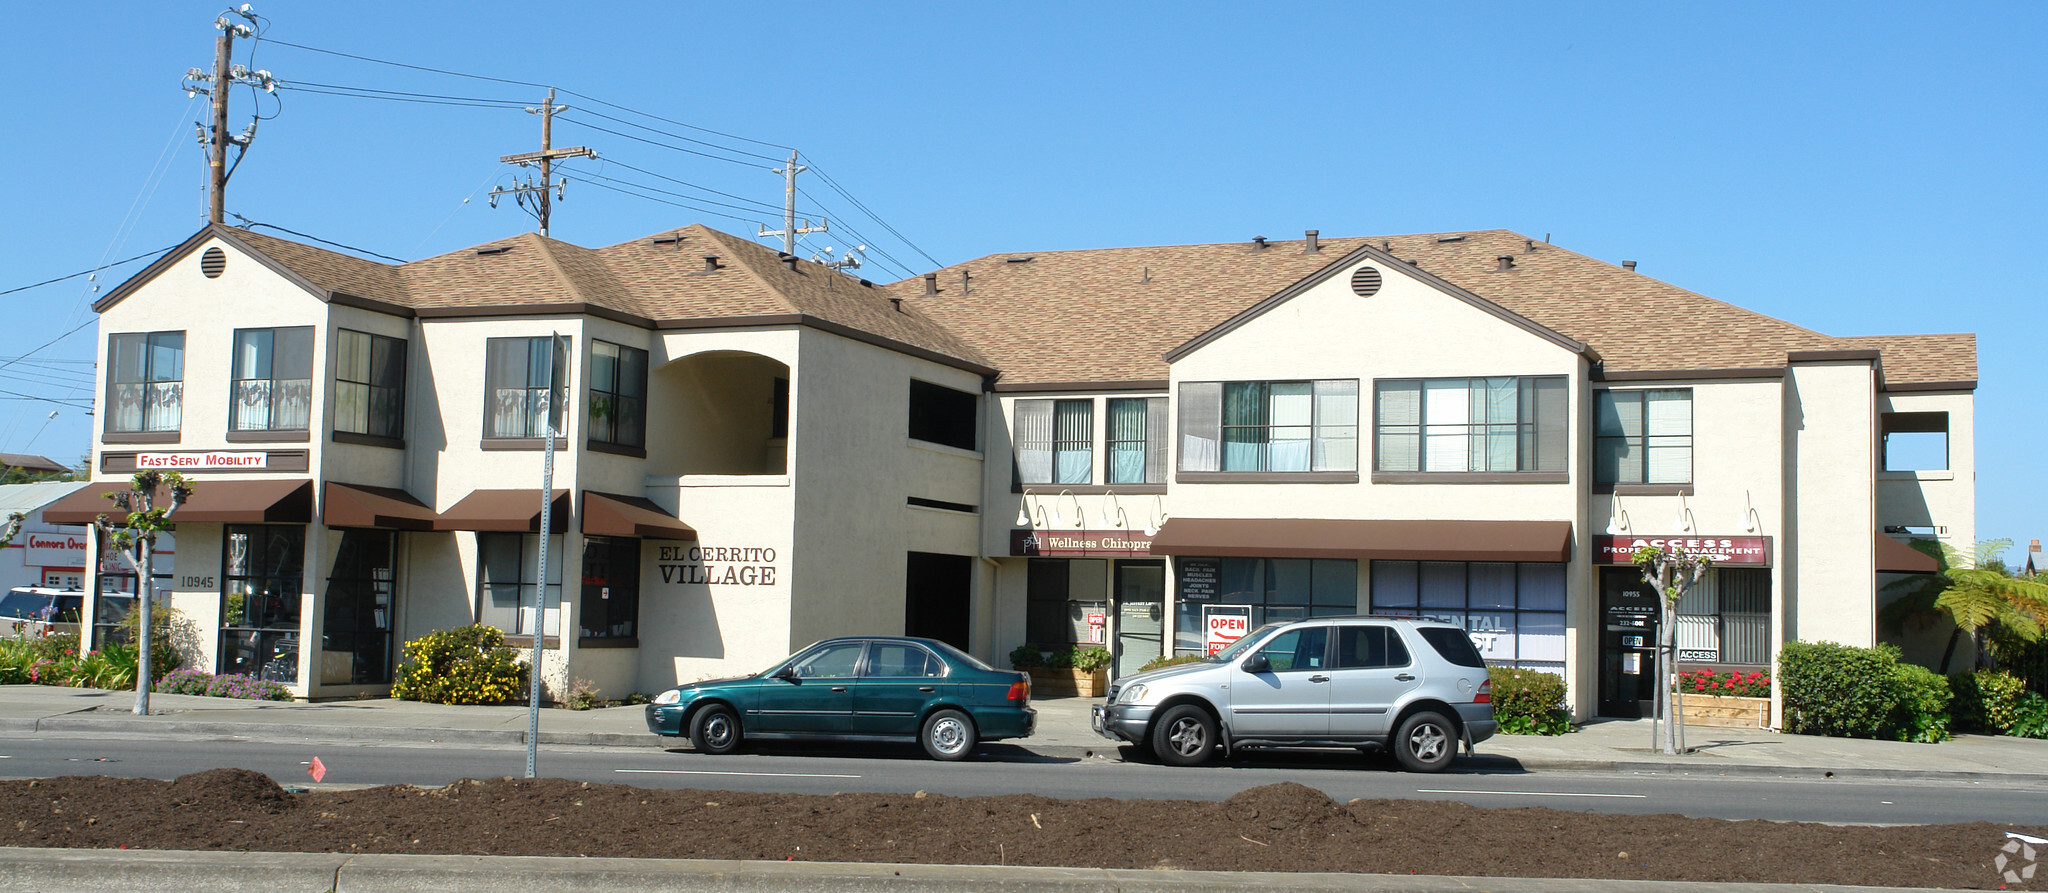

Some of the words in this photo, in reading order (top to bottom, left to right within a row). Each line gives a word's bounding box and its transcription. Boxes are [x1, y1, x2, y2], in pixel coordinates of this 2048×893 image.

[205, 455, 262, 465] MOBILITY
[29, 535, 66, 549] Connors
[1048, 537, 1097, 548] Wellness
[1631, 539, 1733, 547] ACCESS
[658, 546, 685, 561] EL
[688, 546, 777, 563] CERRITO
[658, 564, 776, 586] VILLAGE
[181, 576, 214, 588] 10945
[1210, 618, 1245, 630] OPEN
[1624, 637, 1642, 645] OPEN
[1680, 650, 1717, 659] ACCESS
